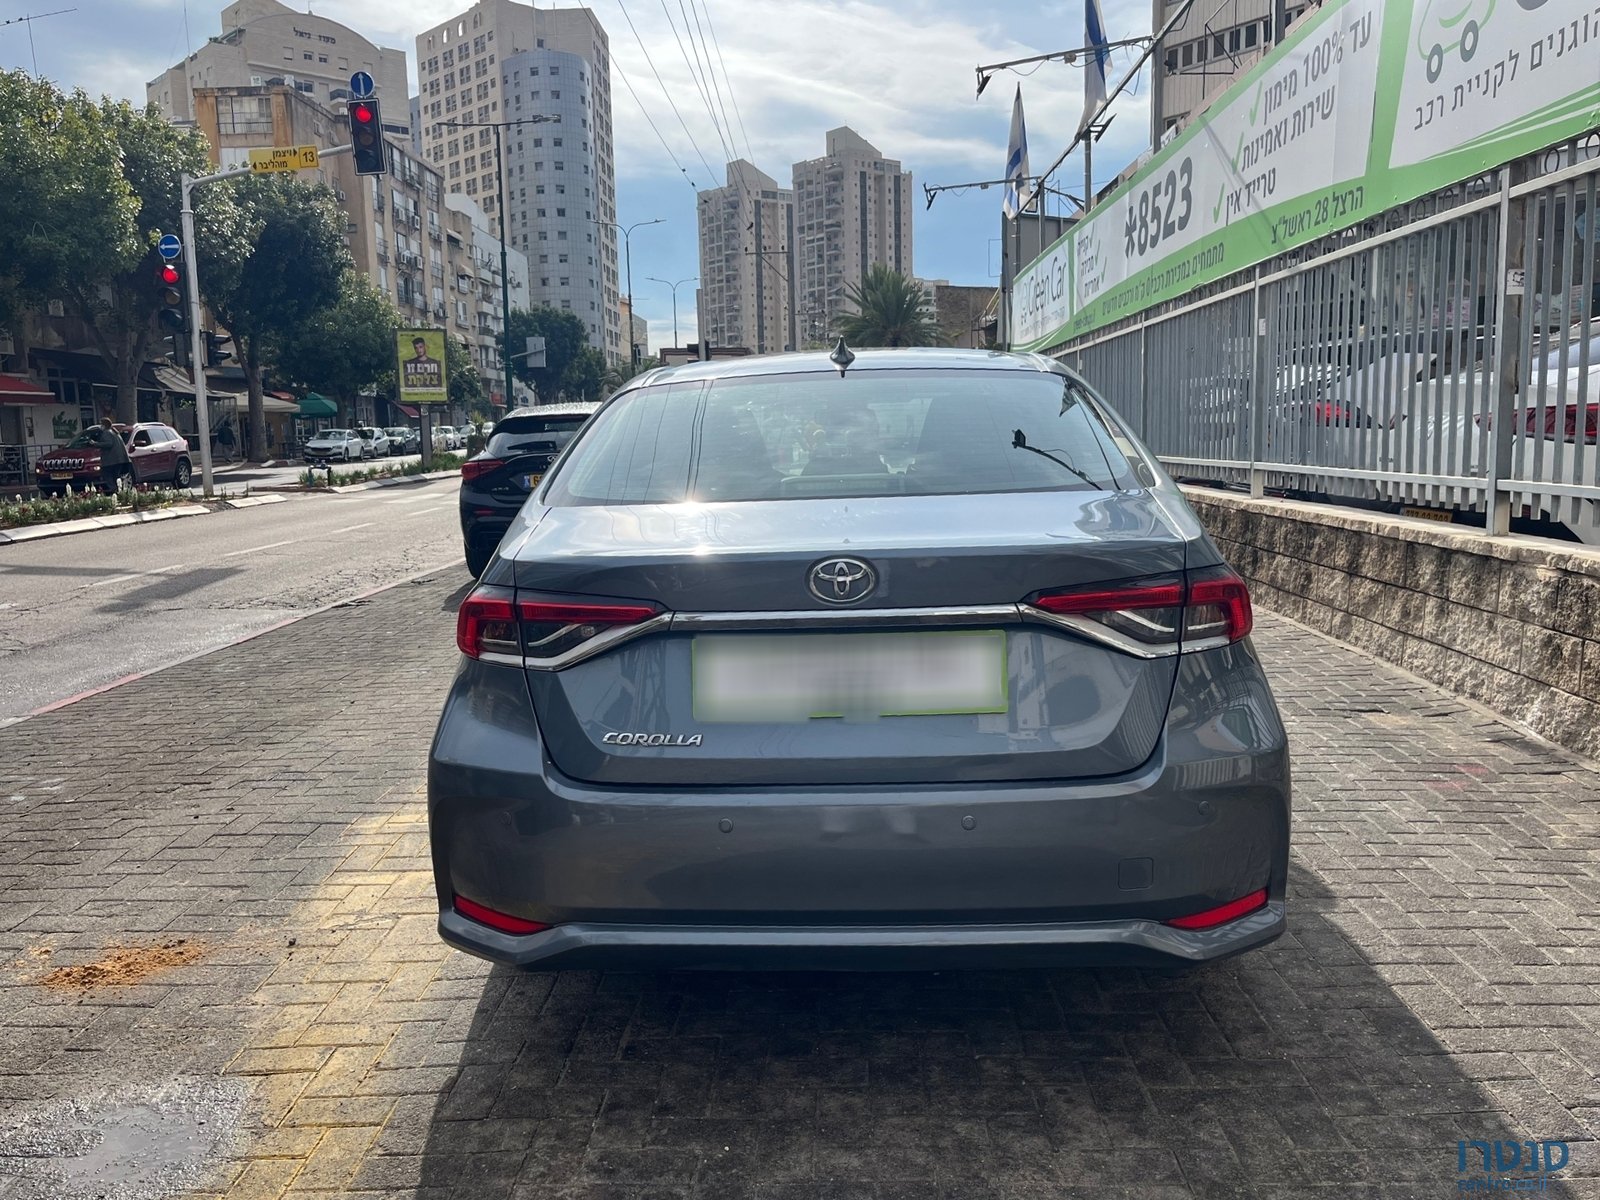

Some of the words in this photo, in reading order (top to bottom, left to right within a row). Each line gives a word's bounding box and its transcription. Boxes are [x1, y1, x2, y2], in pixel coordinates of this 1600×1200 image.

[1349, 11, 1372, 53] עד
[1303, 31, 1343, 87] 100%
[1264, 68, 1298, 125] מימון
[1452, 49, 1519, 111] לקניית
[1290, 85, 1335, 141] שירות
[1414, 95, 1444, 131] רכב
[259, 159, 288, 169] מוהליבר
[272, 149, 292, 160] ויצמן
[302, 151, 315, 163] 13
[1241, 119, 1287, 173] ואמינות
[1245, 167, 1276, 208] טרייד
[1332, 186, 1363, 219] הרצל
[1226, 187, 1242, 226] אין
[1313, 197, 1329, 226] 28
[1192, 242, 1225, 278] מתמחים
[406, 363, 415, 373] זו
[407, 372, 438, 387] צלקת
[417, 363, 438, 373] חרם
[602, 732, 703, 747] COROLLA
